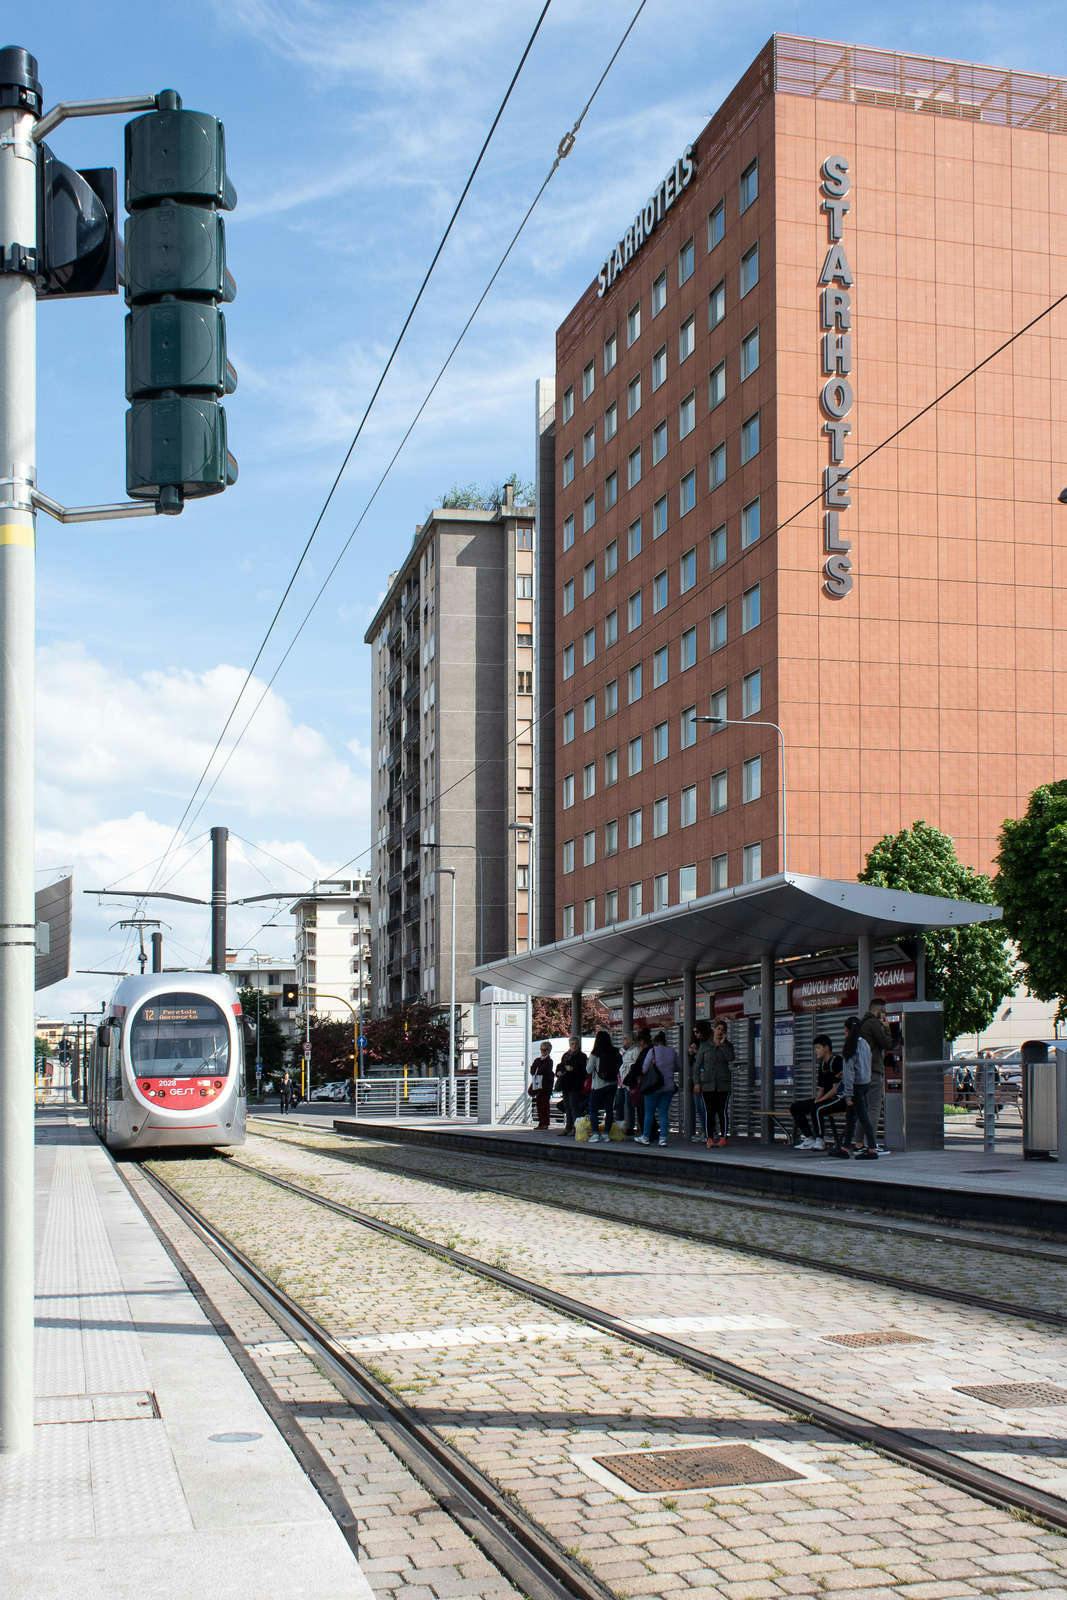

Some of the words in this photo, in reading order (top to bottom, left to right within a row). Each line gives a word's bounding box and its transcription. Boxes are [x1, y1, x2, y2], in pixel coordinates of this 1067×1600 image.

[596, 144, 695, 298] STARHOTELS
[820, 155, 853, 597] STARHOTELS
[801, 979, 829, 996] NOVOLI
[873, 968, 905, 987] OSCANA
[169, 1087, 195, 1096] GEST
